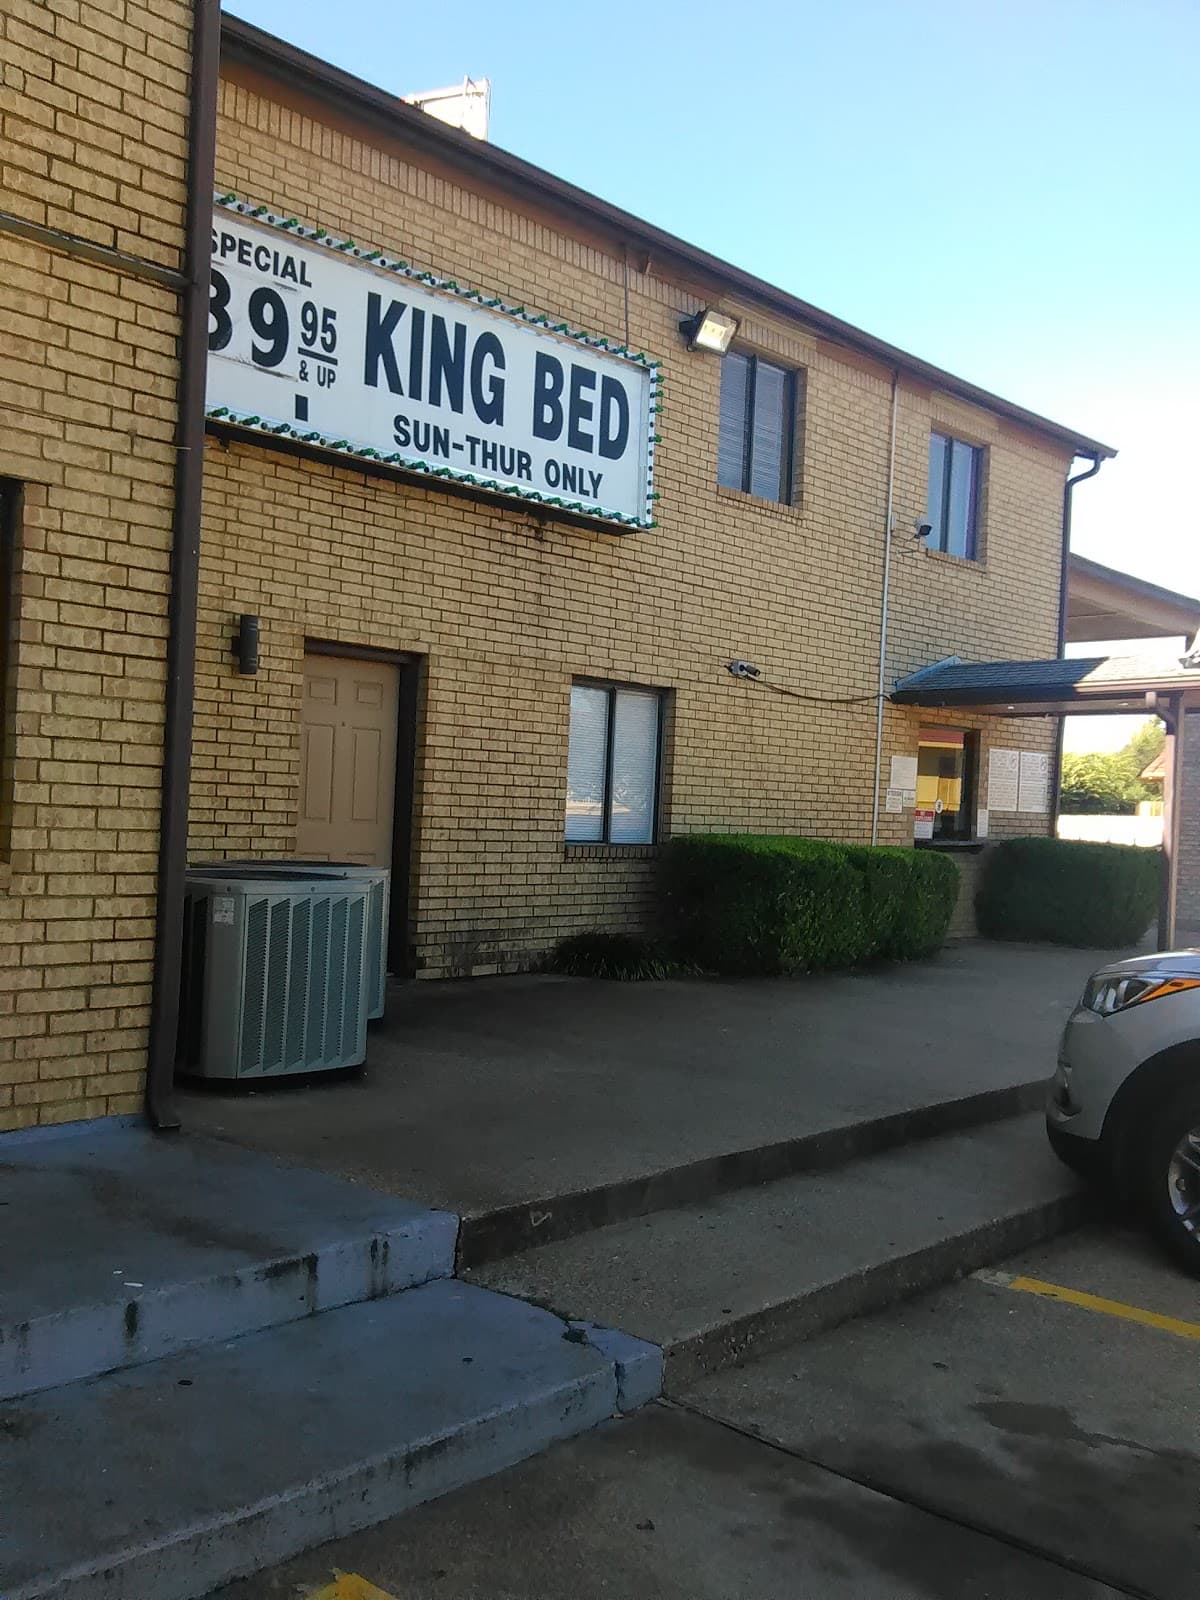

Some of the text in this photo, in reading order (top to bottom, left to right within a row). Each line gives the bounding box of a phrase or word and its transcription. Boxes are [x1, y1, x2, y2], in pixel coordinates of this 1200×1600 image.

[300, 300, 337, 354] 95
[298, 359, 336, 389] & UP
[364, 291, 630, 461] KING BED
[393, 414, 603, 500] SUN-THUR ONLY
